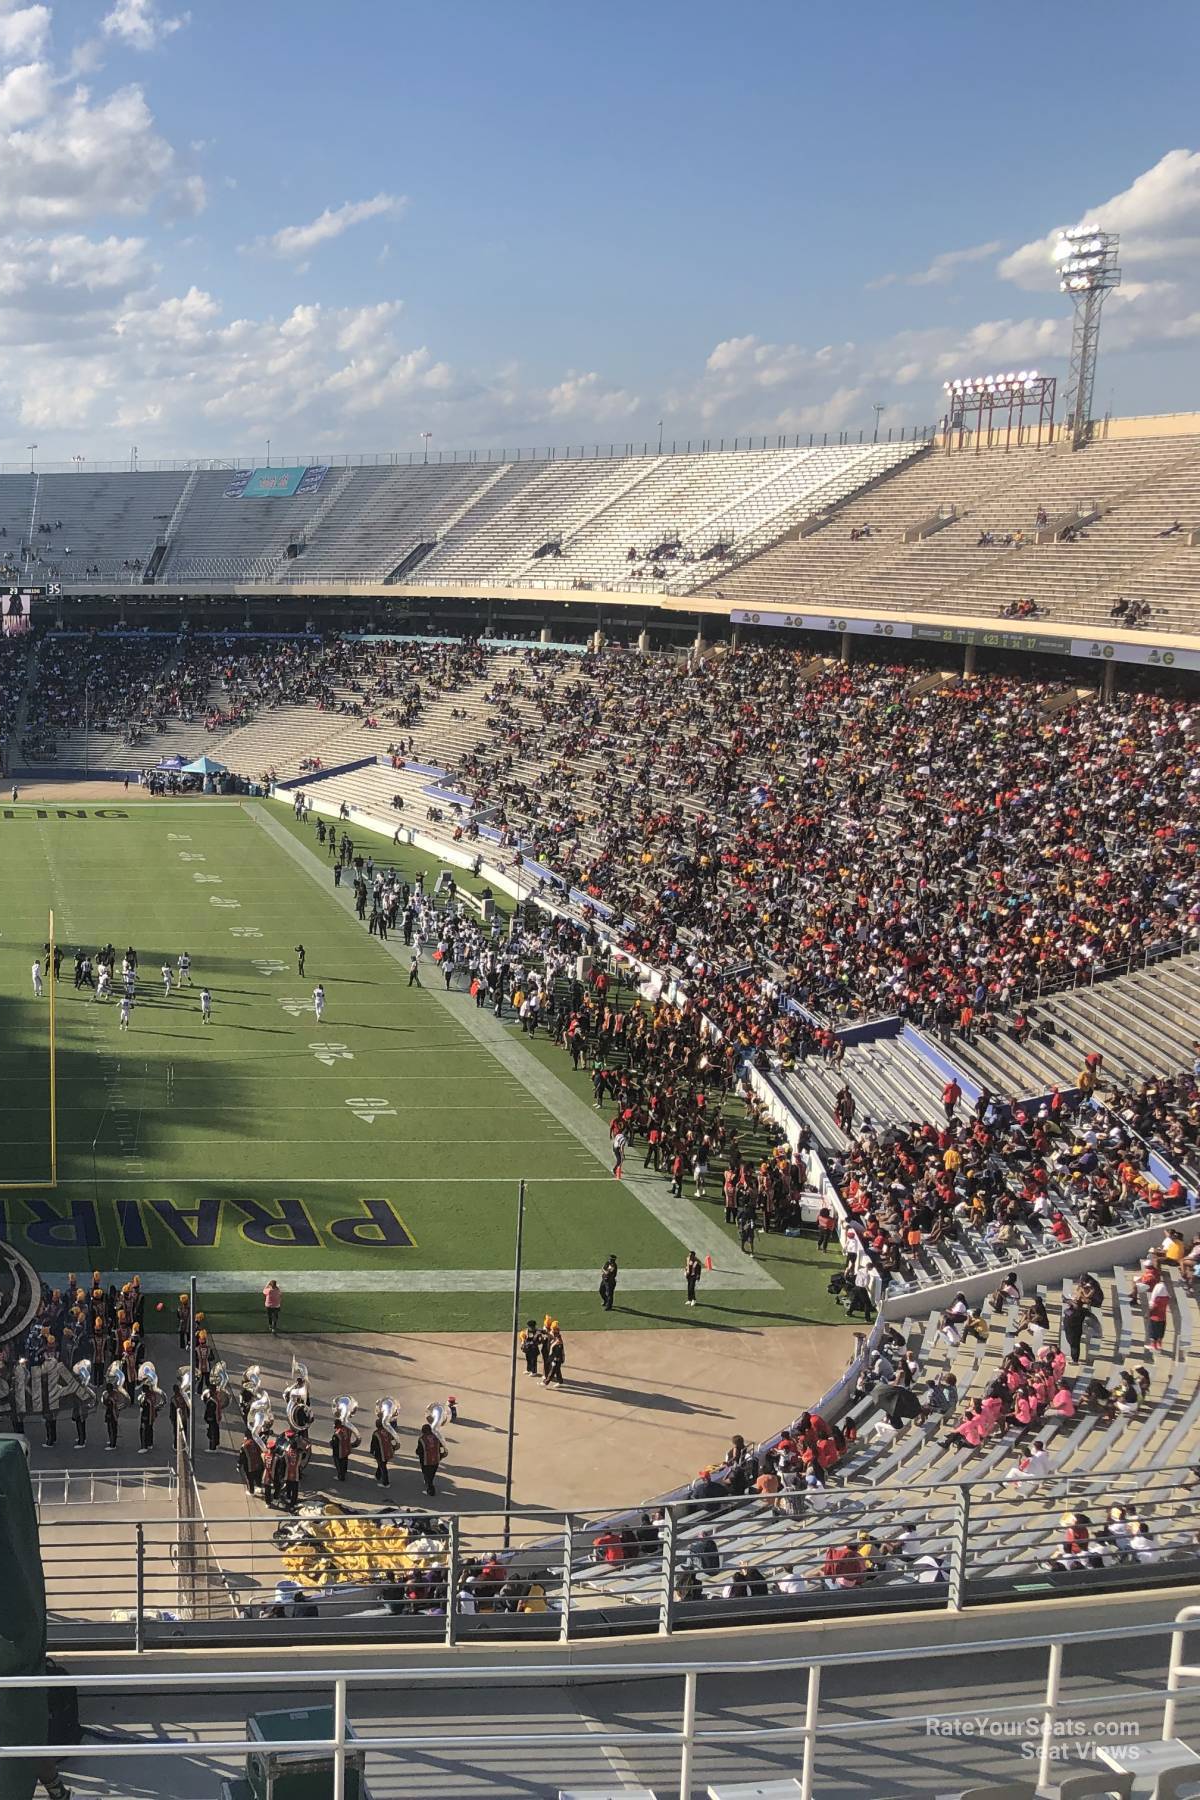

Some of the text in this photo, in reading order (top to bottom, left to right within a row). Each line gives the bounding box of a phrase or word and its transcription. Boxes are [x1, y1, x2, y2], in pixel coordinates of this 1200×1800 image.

[49, 583, 60, 594] 35
[307, 1043, 356, 1060] 20
[344, 1098, 398, 1115] 10
